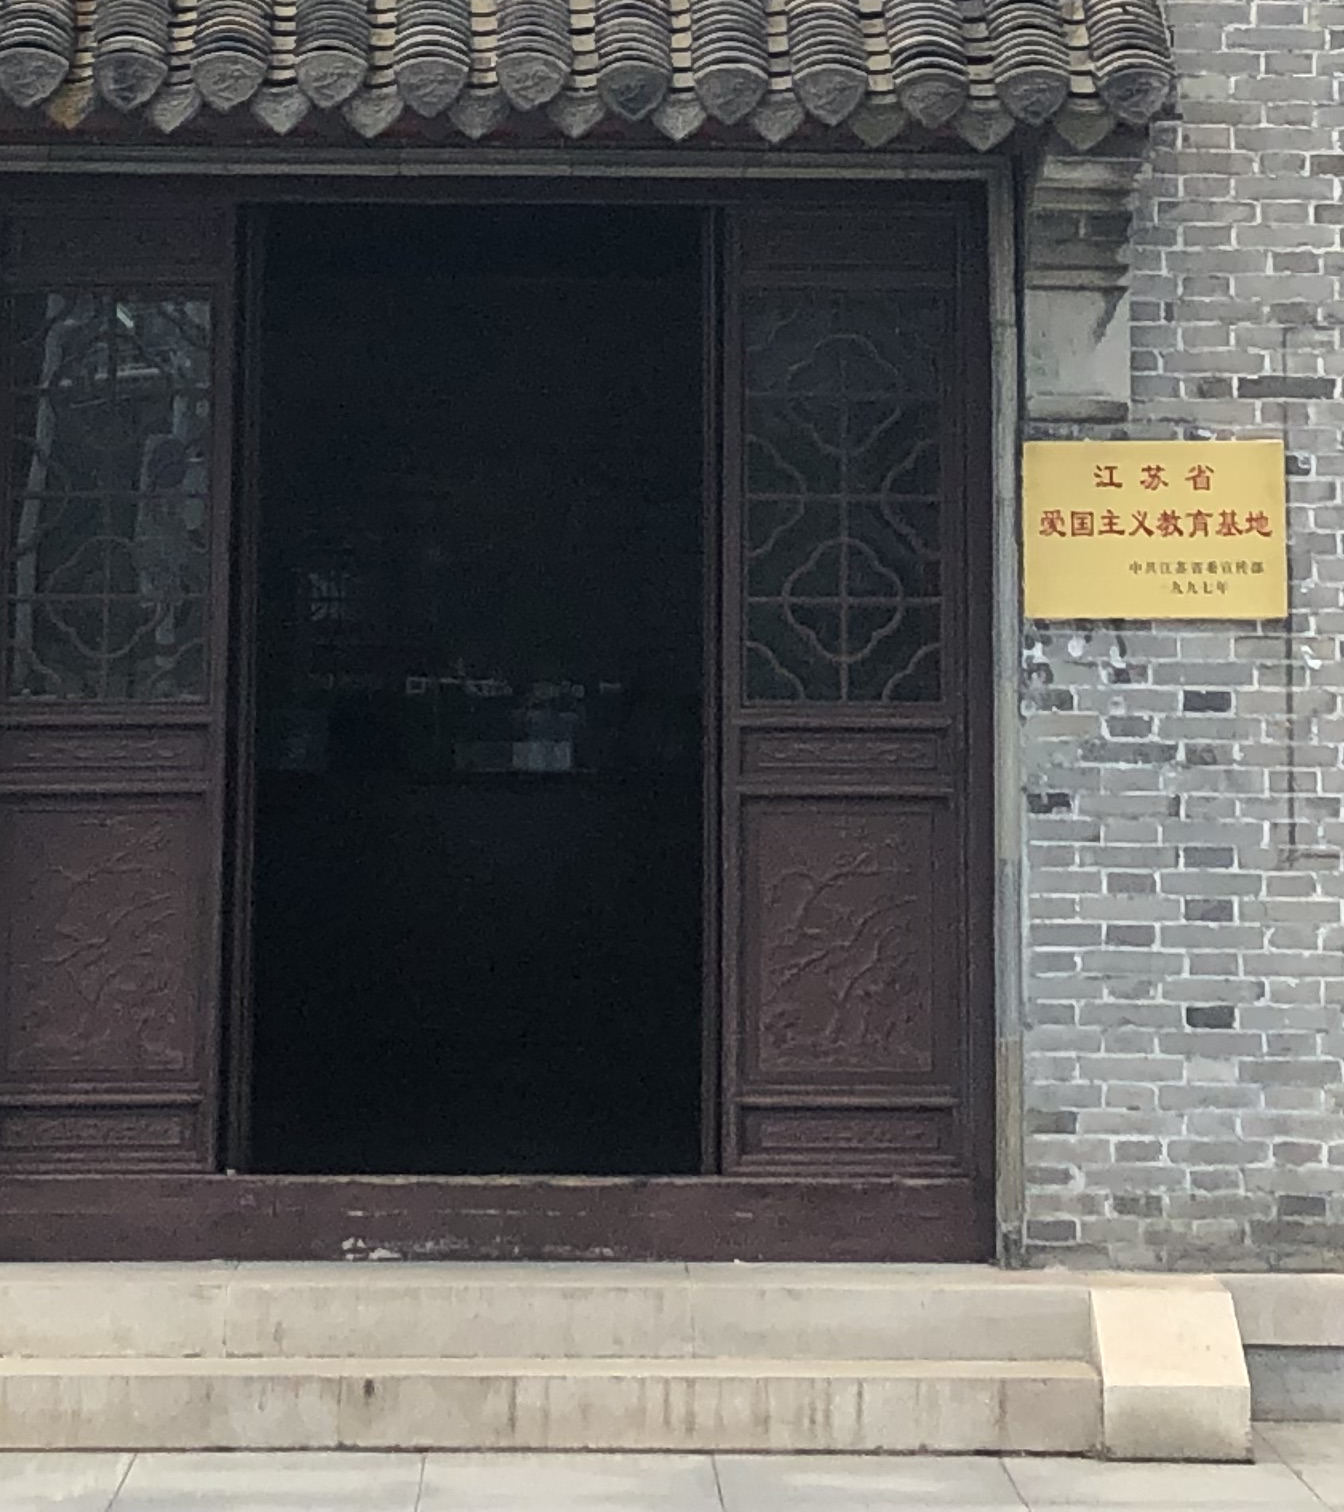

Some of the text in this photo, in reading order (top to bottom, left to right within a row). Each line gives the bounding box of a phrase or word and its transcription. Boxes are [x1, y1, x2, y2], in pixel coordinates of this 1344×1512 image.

[1093, 464, 1215, 491] 江苏省
[1038, 508, 1274, 538] 爱国主义教育基地
